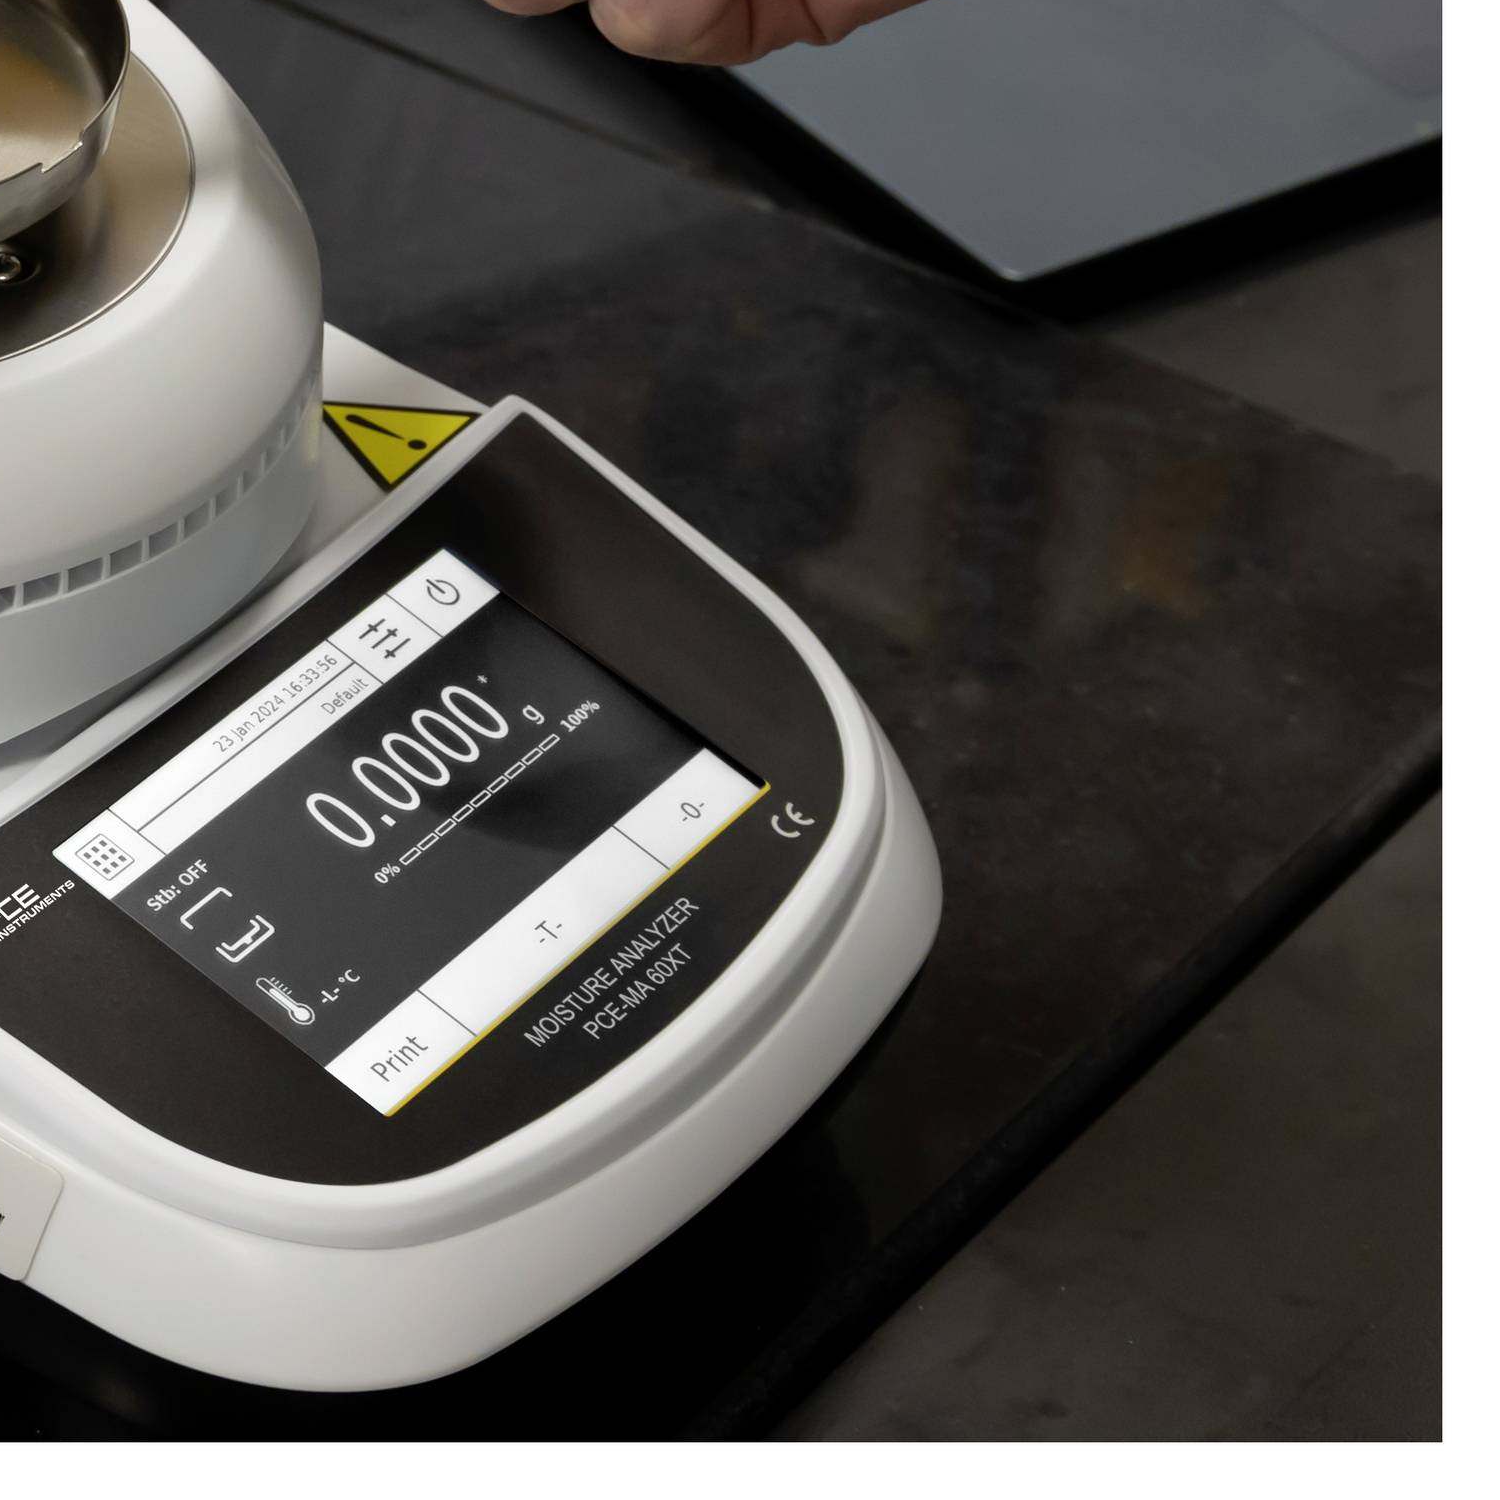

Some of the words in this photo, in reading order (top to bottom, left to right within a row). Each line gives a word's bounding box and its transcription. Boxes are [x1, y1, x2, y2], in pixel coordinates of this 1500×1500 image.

[212, 735, 234, 752] 23
[231, 720, 255, 741] Jan
[250, 695, 286, 723] 2024
[282, 654, 338, 699] 16:33:56
[320, 677, 369, 715] Default
[560, 700, 600, 732] 100%
[306, 685, 509, 848] 0.0000
[522, 704, 545, 725] g
[146, 884, 182, 912] Stb:
[178, 859, 209, 887] OFF
[374, 863, 401, 884] 0%
[523, 967, 618, 1048] MOISTURE
[609, 897, 700, 976] ANALYZER
[582, 980, 656, 1040] PCE-MA
[646, 943, 692, 985] 60XT
[369, 1035, 429, 1082] Print
